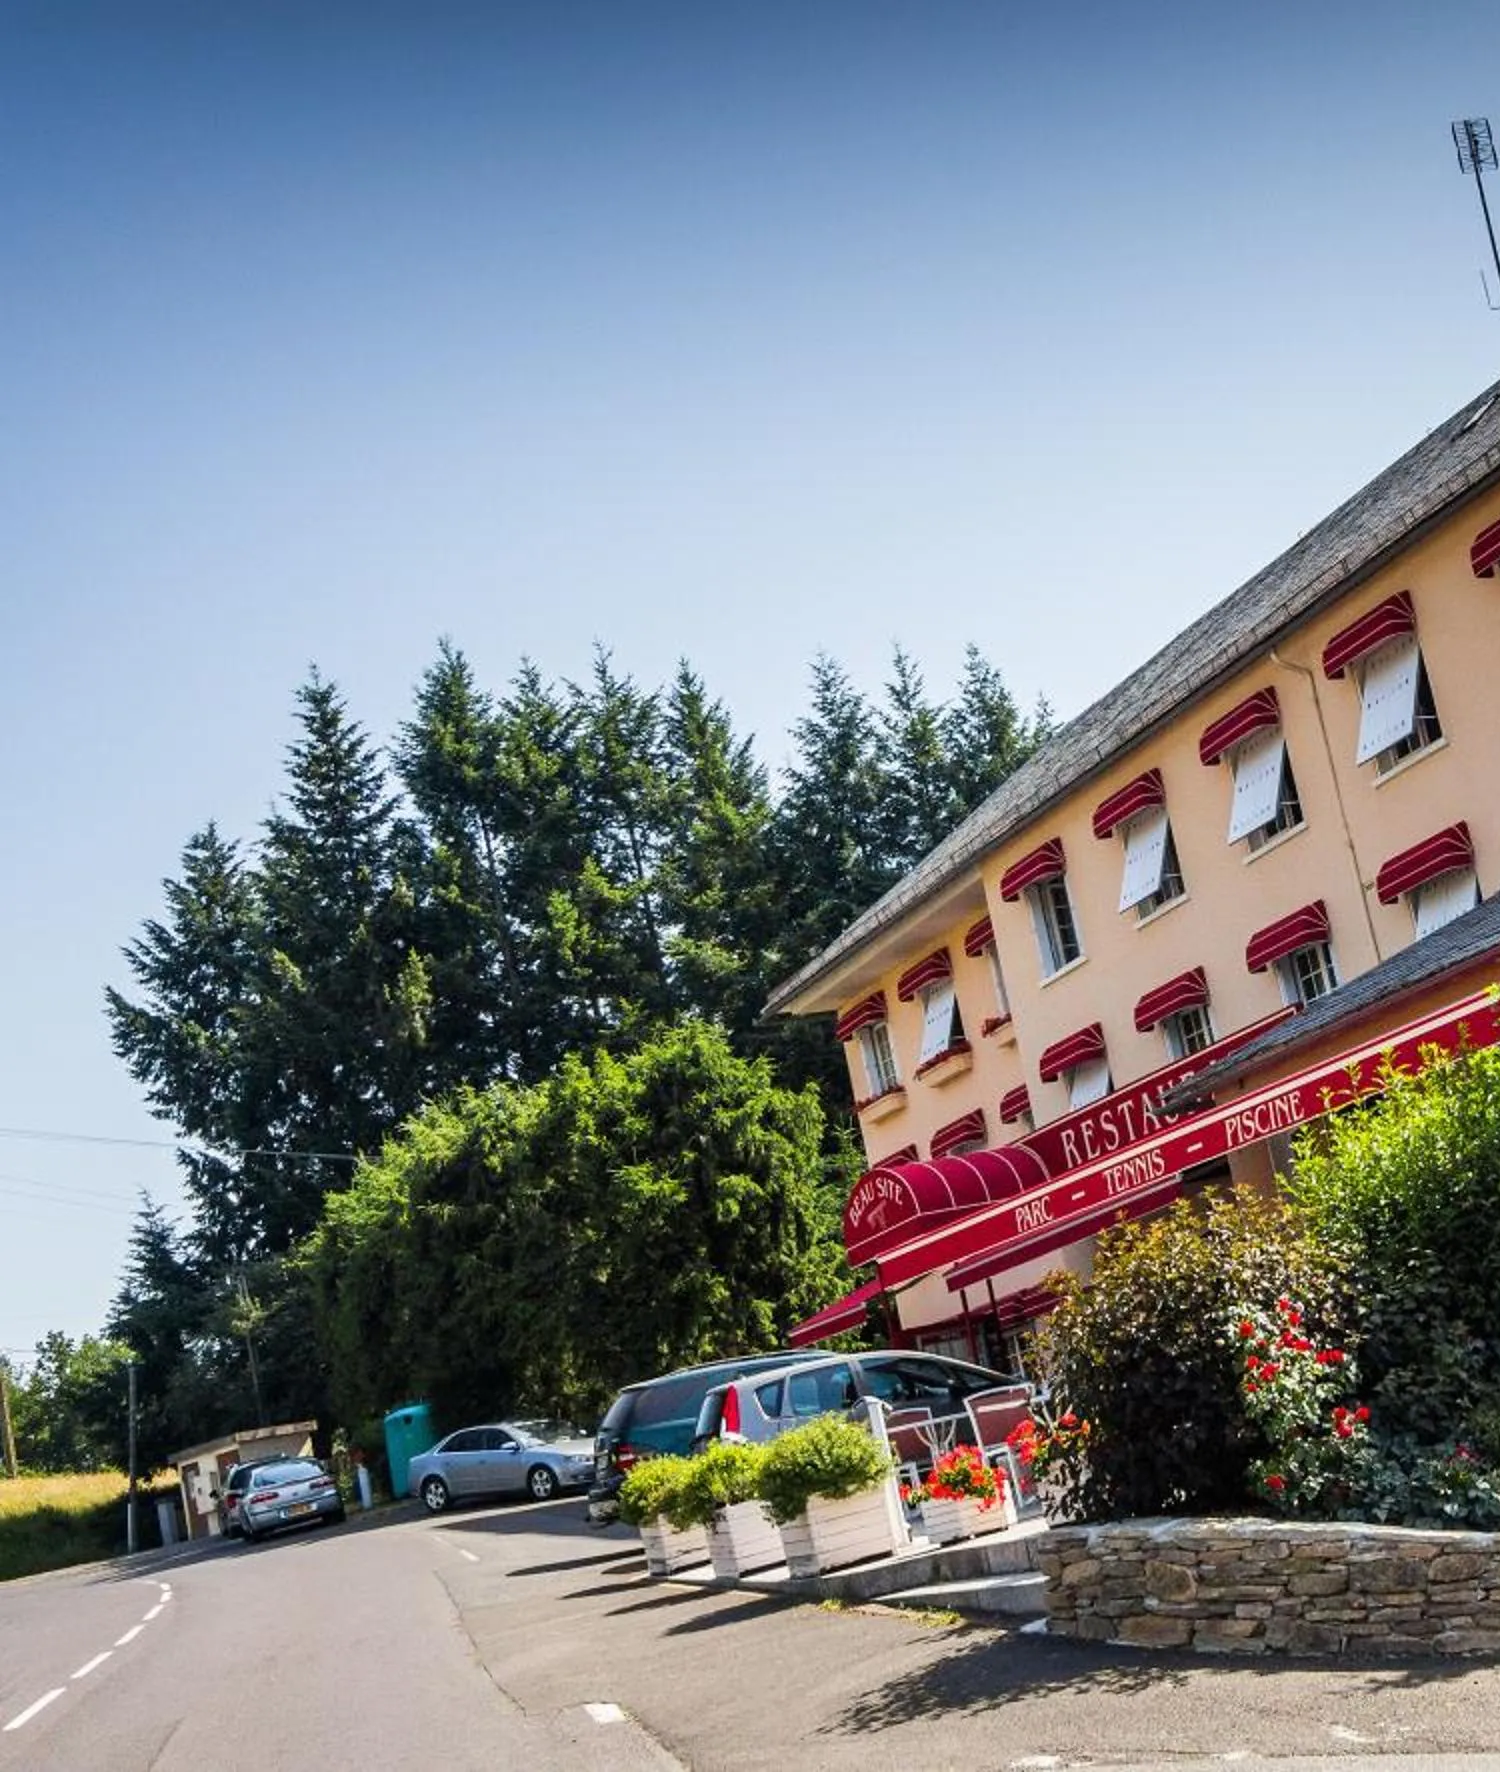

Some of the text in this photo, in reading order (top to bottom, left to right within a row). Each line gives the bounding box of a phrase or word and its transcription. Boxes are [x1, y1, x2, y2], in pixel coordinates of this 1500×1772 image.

[849, 1176, 904, 1228] BEAU SITE
[1015, 1195, 1054, 1233] PARC
[1103, 1149, 1166, 1195] TENNIS
[1224, 1090, 1305, 1148] PISCINE
